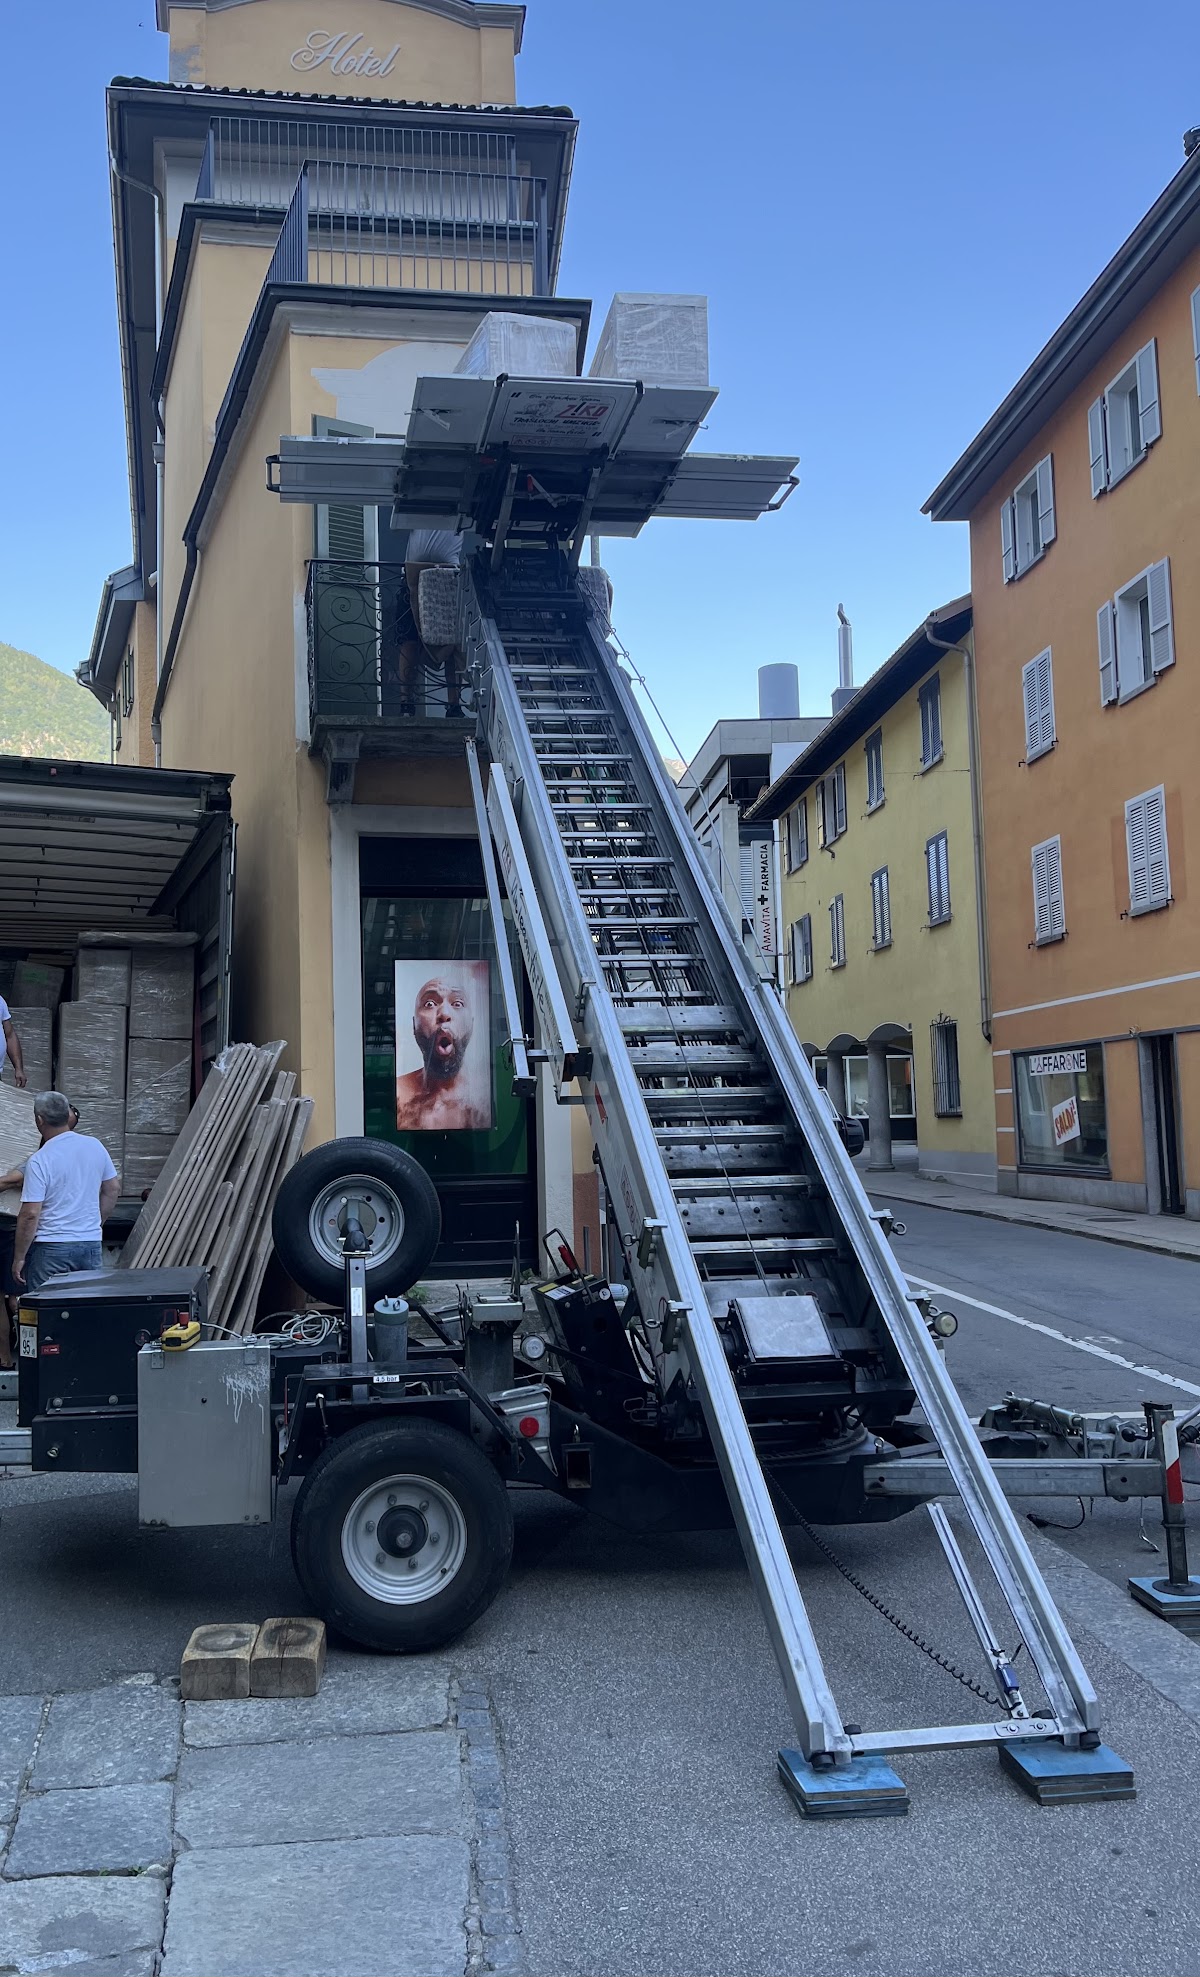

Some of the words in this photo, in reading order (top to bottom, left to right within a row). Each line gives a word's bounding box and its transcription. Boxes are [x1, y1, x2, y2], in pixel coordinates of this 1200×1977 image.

[290, 30, 401, 78] Hotel
[760, 844, 769, 891] FARMACIA
[761, 907, 773, 952] AMAVITA
[22, 1339, 31, 1355] 95
